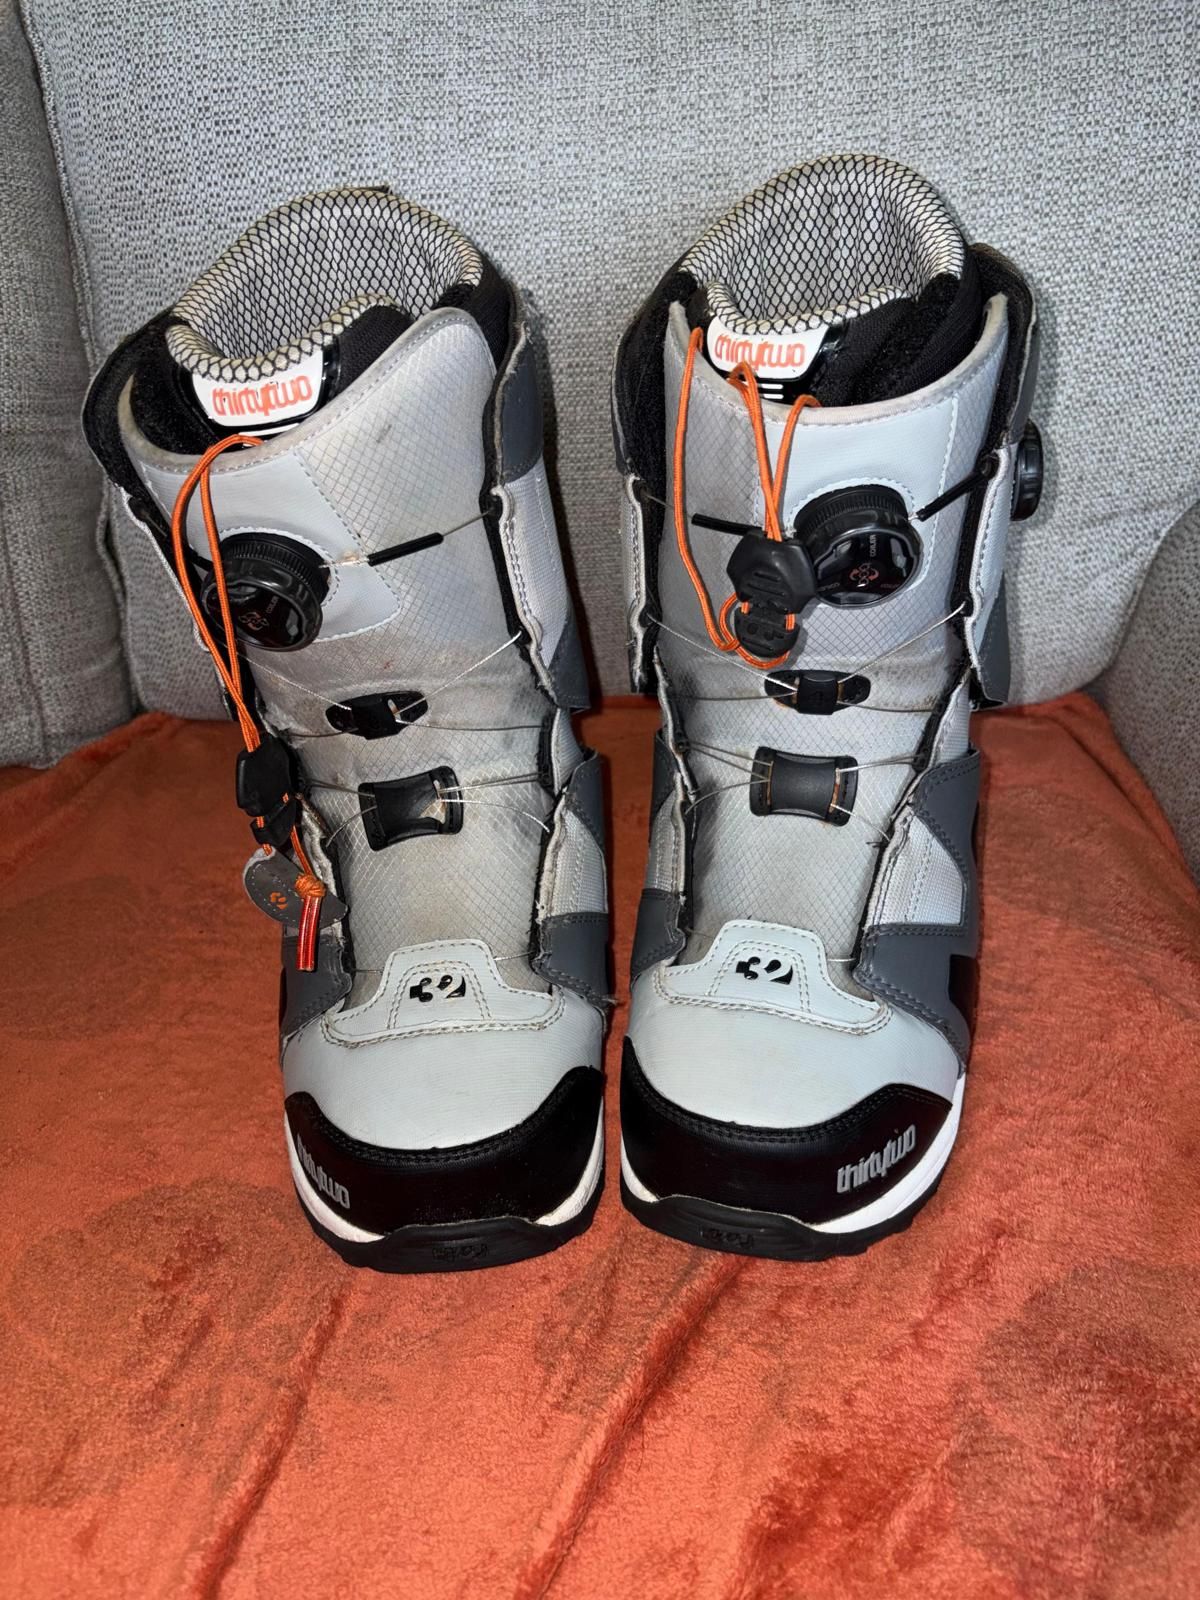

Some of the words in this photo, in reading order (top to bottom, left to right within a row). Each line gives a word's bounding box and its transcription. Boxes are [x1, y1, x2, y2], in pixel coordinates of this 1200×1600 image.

[714, 333, 806, 371] thirtytwo
[211, 375, 313, 417] thirtytwo
[410, 974, 466, 1003] 32
[736, 956, 794, 985] 32
[836, 1124, 917, 1194] thirtytwo
